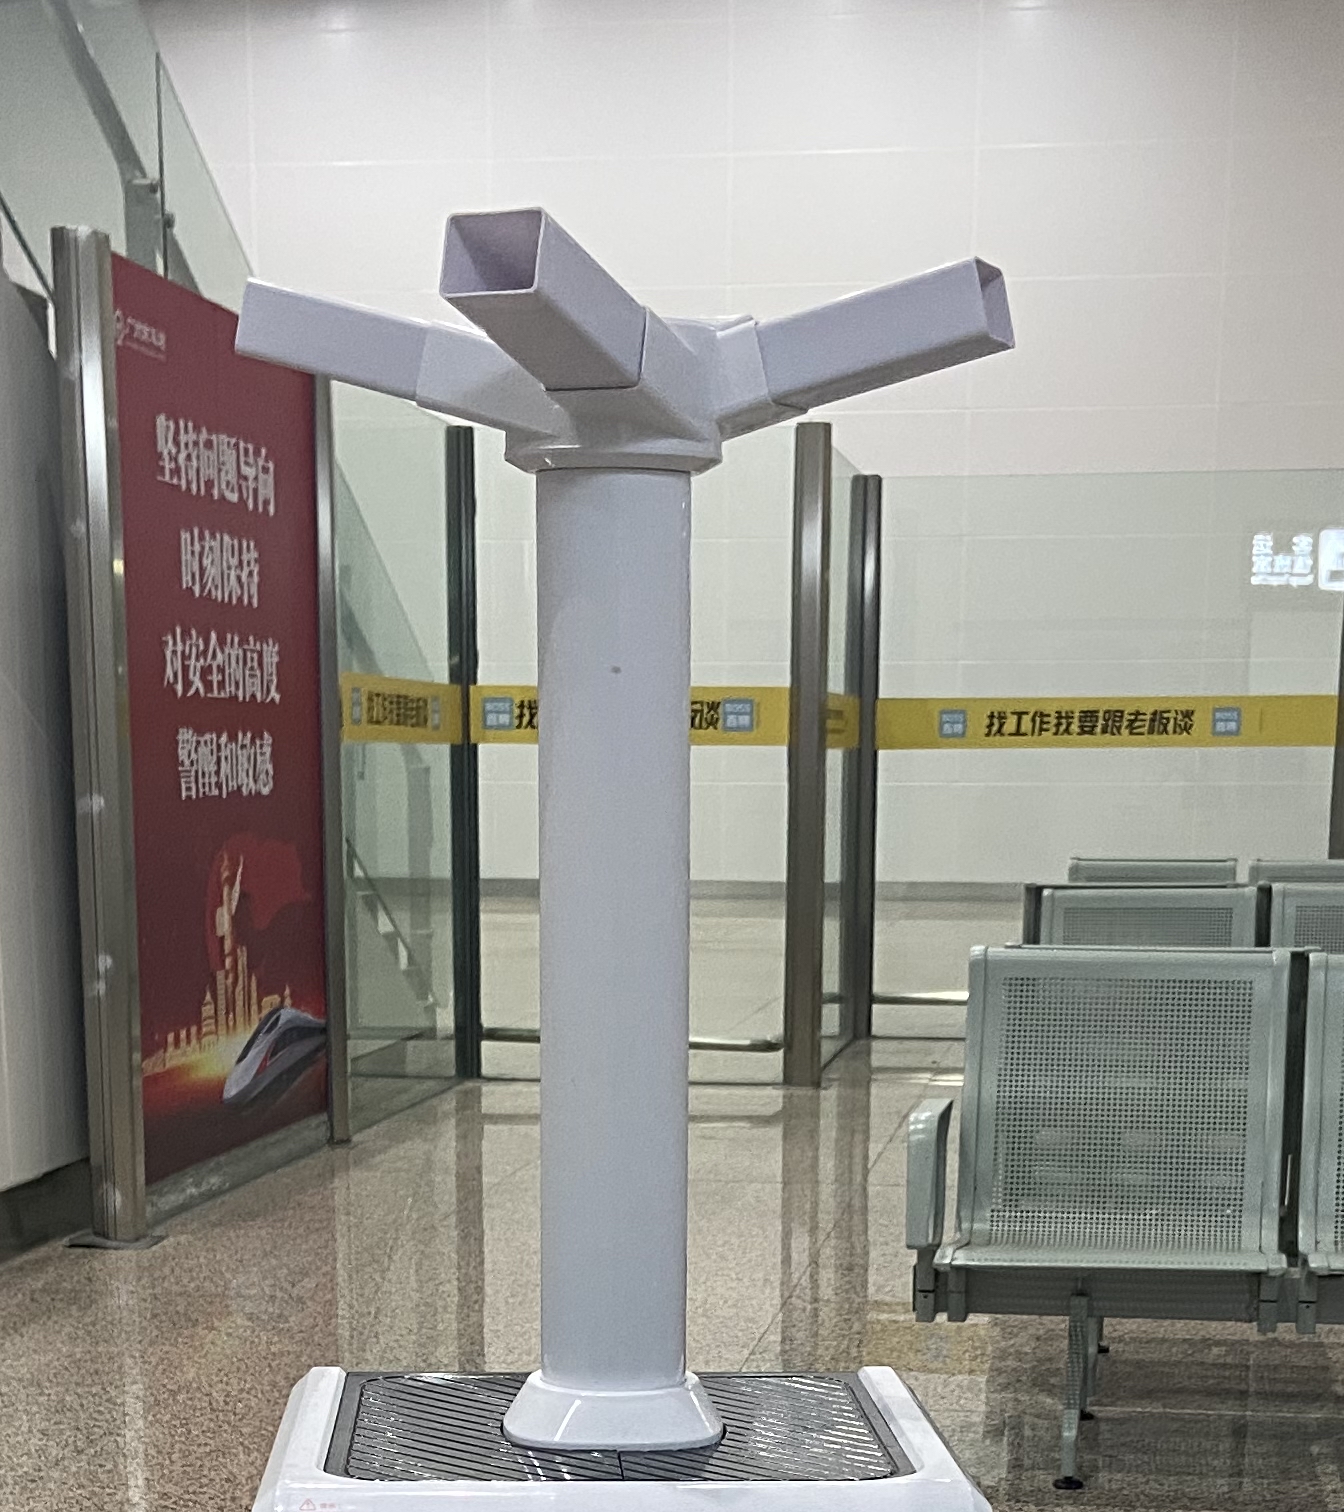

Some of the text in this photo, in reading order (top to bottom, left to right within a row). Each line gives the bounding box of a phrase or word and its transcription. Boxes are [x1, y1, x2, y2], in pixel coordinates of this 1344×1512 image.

[156, 412, 275, 517] 坚持问题导向
[180, 526, 260, 609] 时刻保持
[162, 624, 281, 705] 对安全的高度
[177, 726, 274, 800] 警醒和敏感
[984, 709, 1196, 738] 找工作我要跟老板谈
